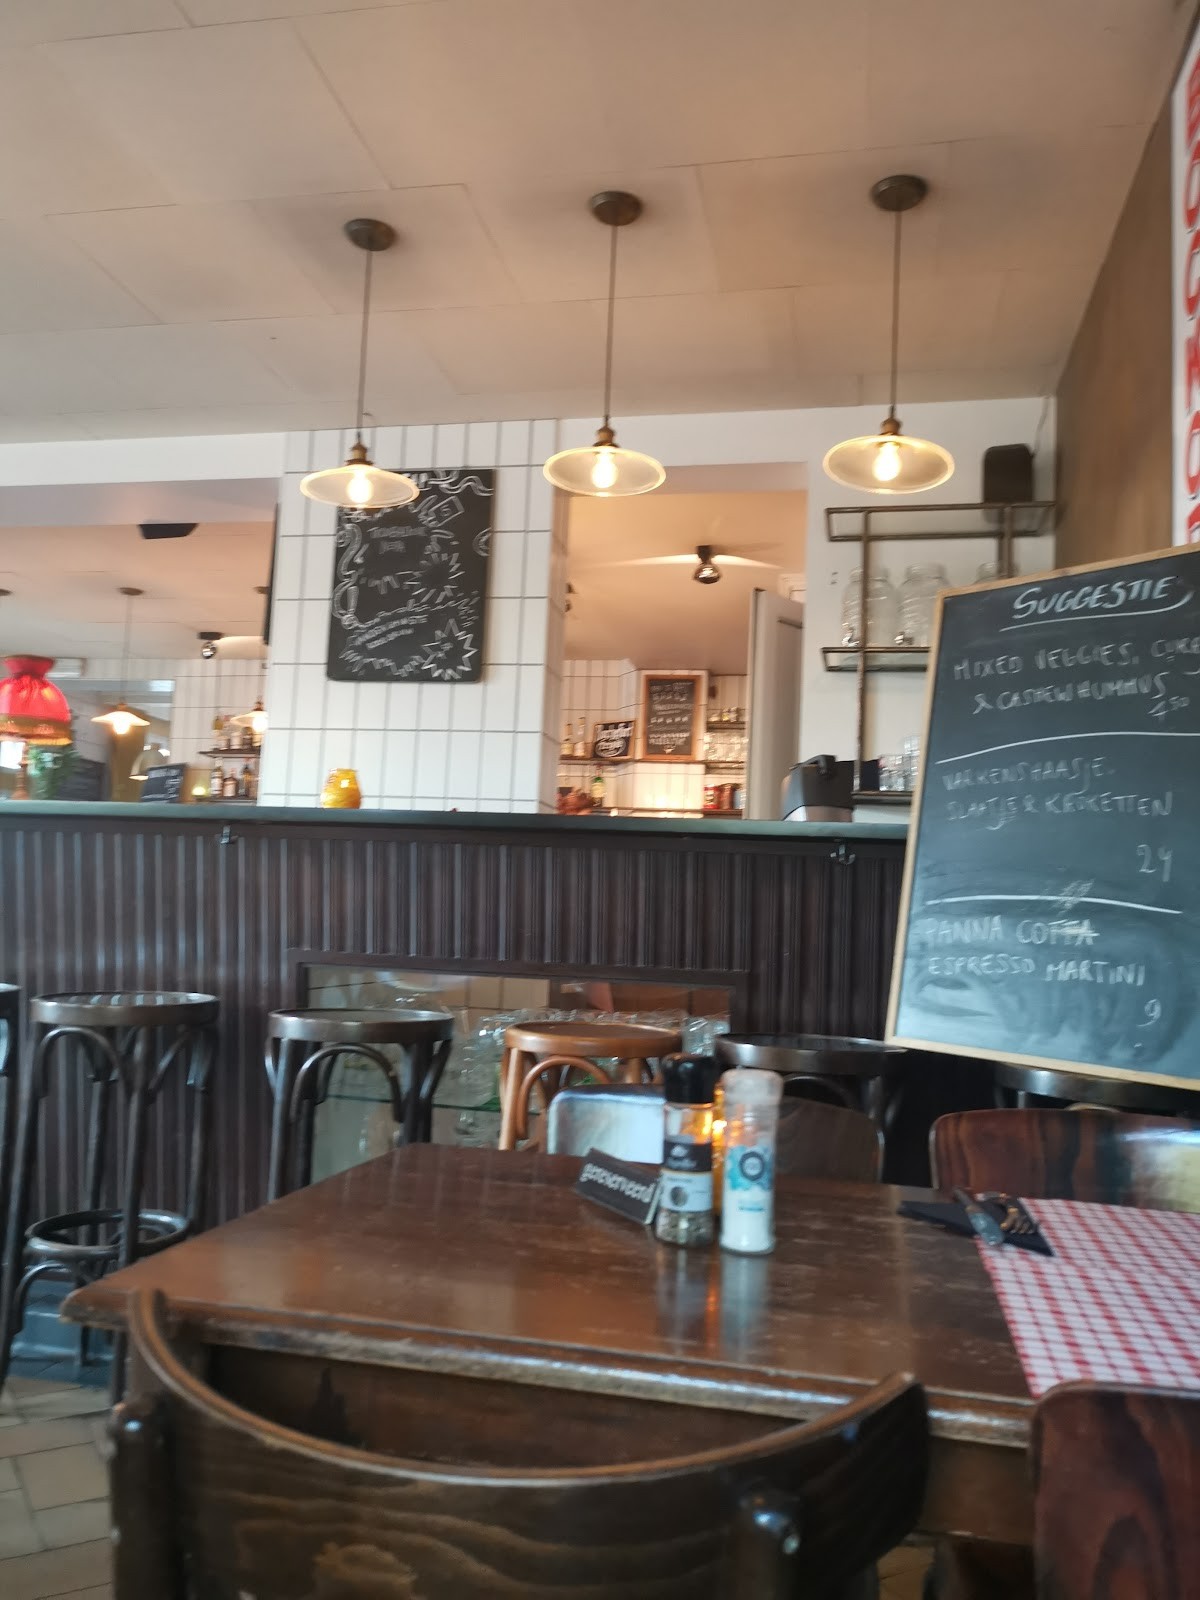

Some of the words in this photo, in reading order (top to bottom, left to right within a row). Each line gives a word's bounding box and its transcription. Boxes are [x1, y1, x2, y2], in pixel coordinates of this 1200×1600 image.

[1012, 576, 1176, 619] SUGGESTIE
[954, 655, 1024, 680] MIXED
[1137, 843, 1173, 882] 24
[921, 915, 1003, 945] PANNA
[928, 953, 1036, 976] ESPRESSO
[1046, 959, 1145, 986] MARTINI
[1137, 998, 1162, 1027] 9
